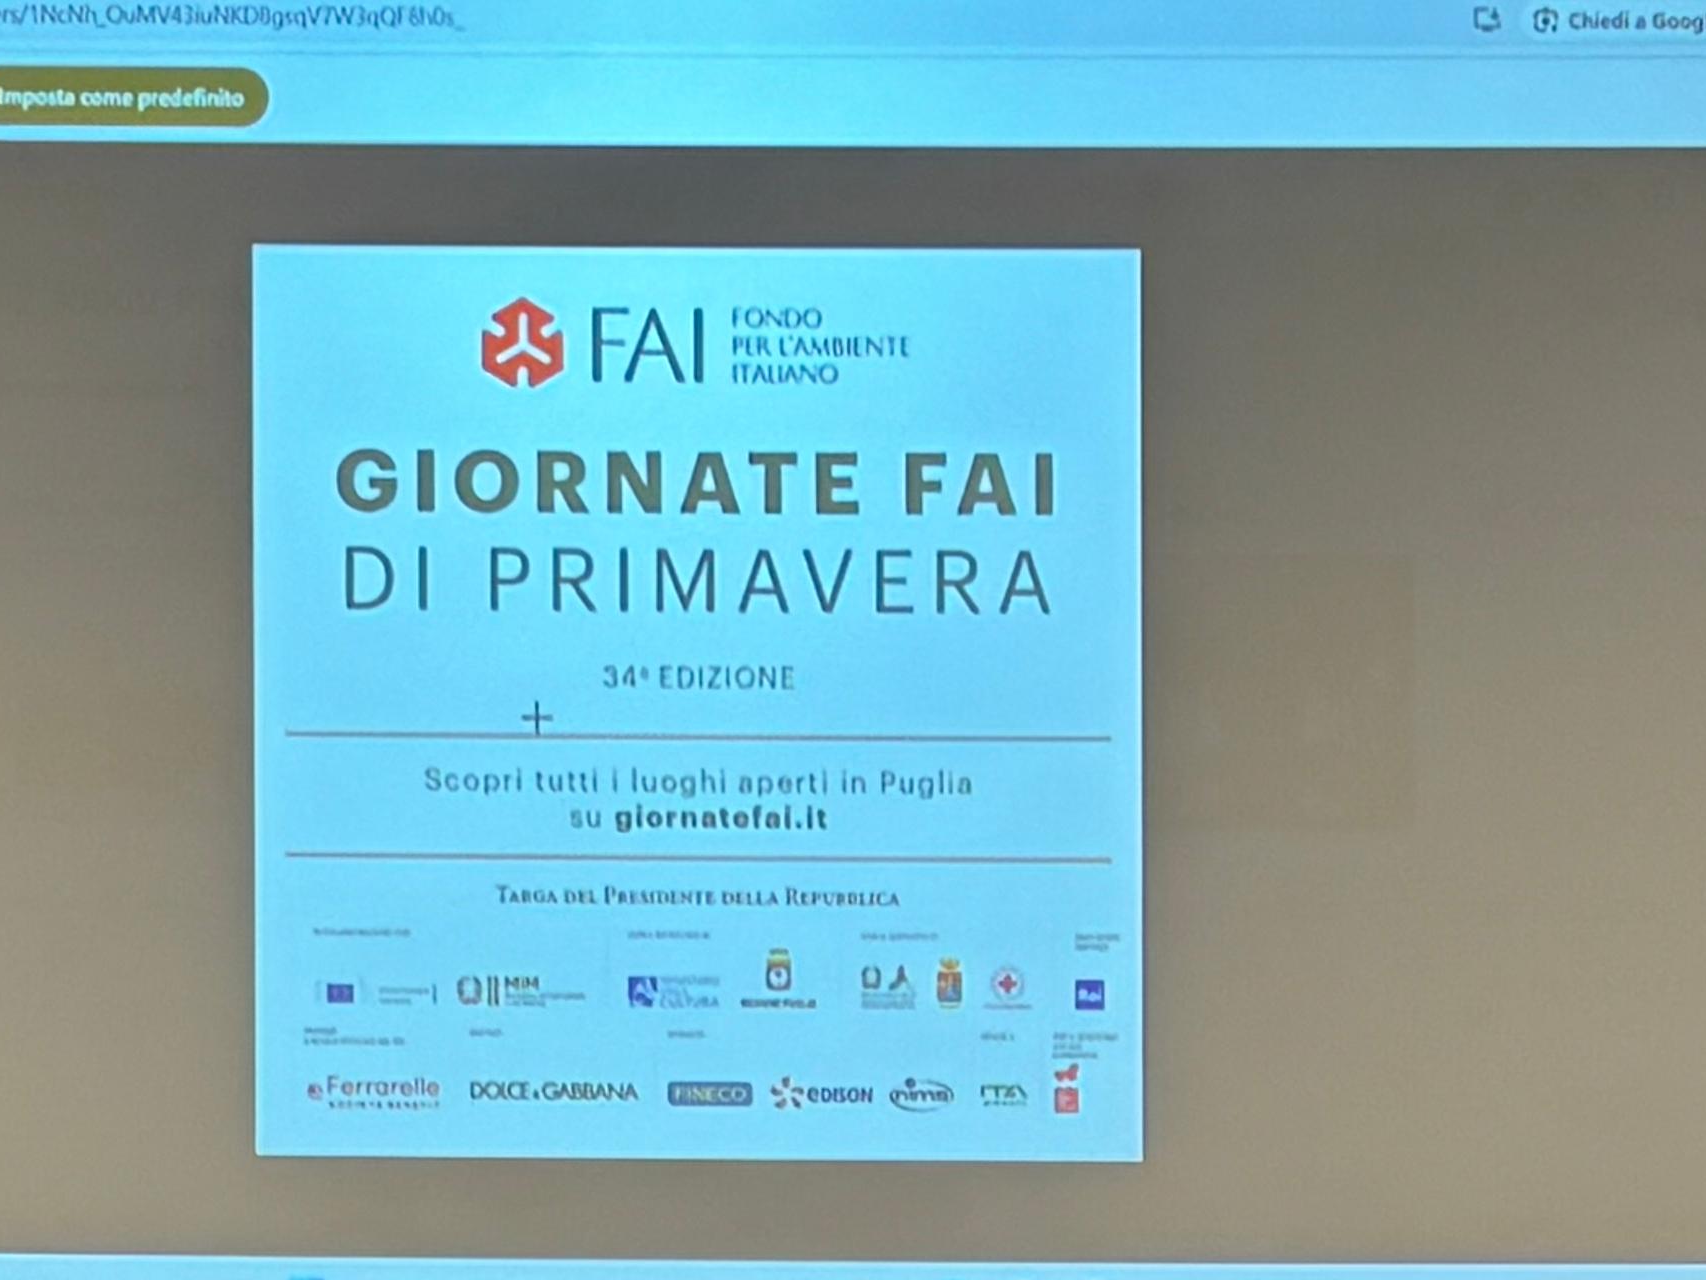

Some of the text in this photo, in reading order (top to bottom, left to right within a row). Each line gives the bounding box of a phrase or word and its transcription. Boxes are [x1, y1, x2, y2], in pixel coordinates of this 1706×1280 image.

[1568, 11, 1631, 31] Chiedi
[1634, 16, 1647, 31] a
[80, 91, 133, 108] come
[137, 87, 245, 113] predefinito
[731, 306, 823, 330] FONDO
[591, 307, 704, 384] FAI
[731, 335, 911, 359] PER L'AMBIENTE
[731, 363, 840, 386] ITALIANO
[335, 447, 1056, 516] GIORNATE FAI
[345, 546, 1053, 616] DI PRIMAVERA
[659, 665, 796, 691] EDIZIONE
[424, 767, 974, 805] Scopri tutti i luoghi aperti in Puglia
[571, 804, 829, 836] su giornatefai.it
[326, 1074, 441, 1098] Ferrarelle
[470, 1080, 530, 1101] DOLCE
[543, 1081, 639, 1102] GABBANA
